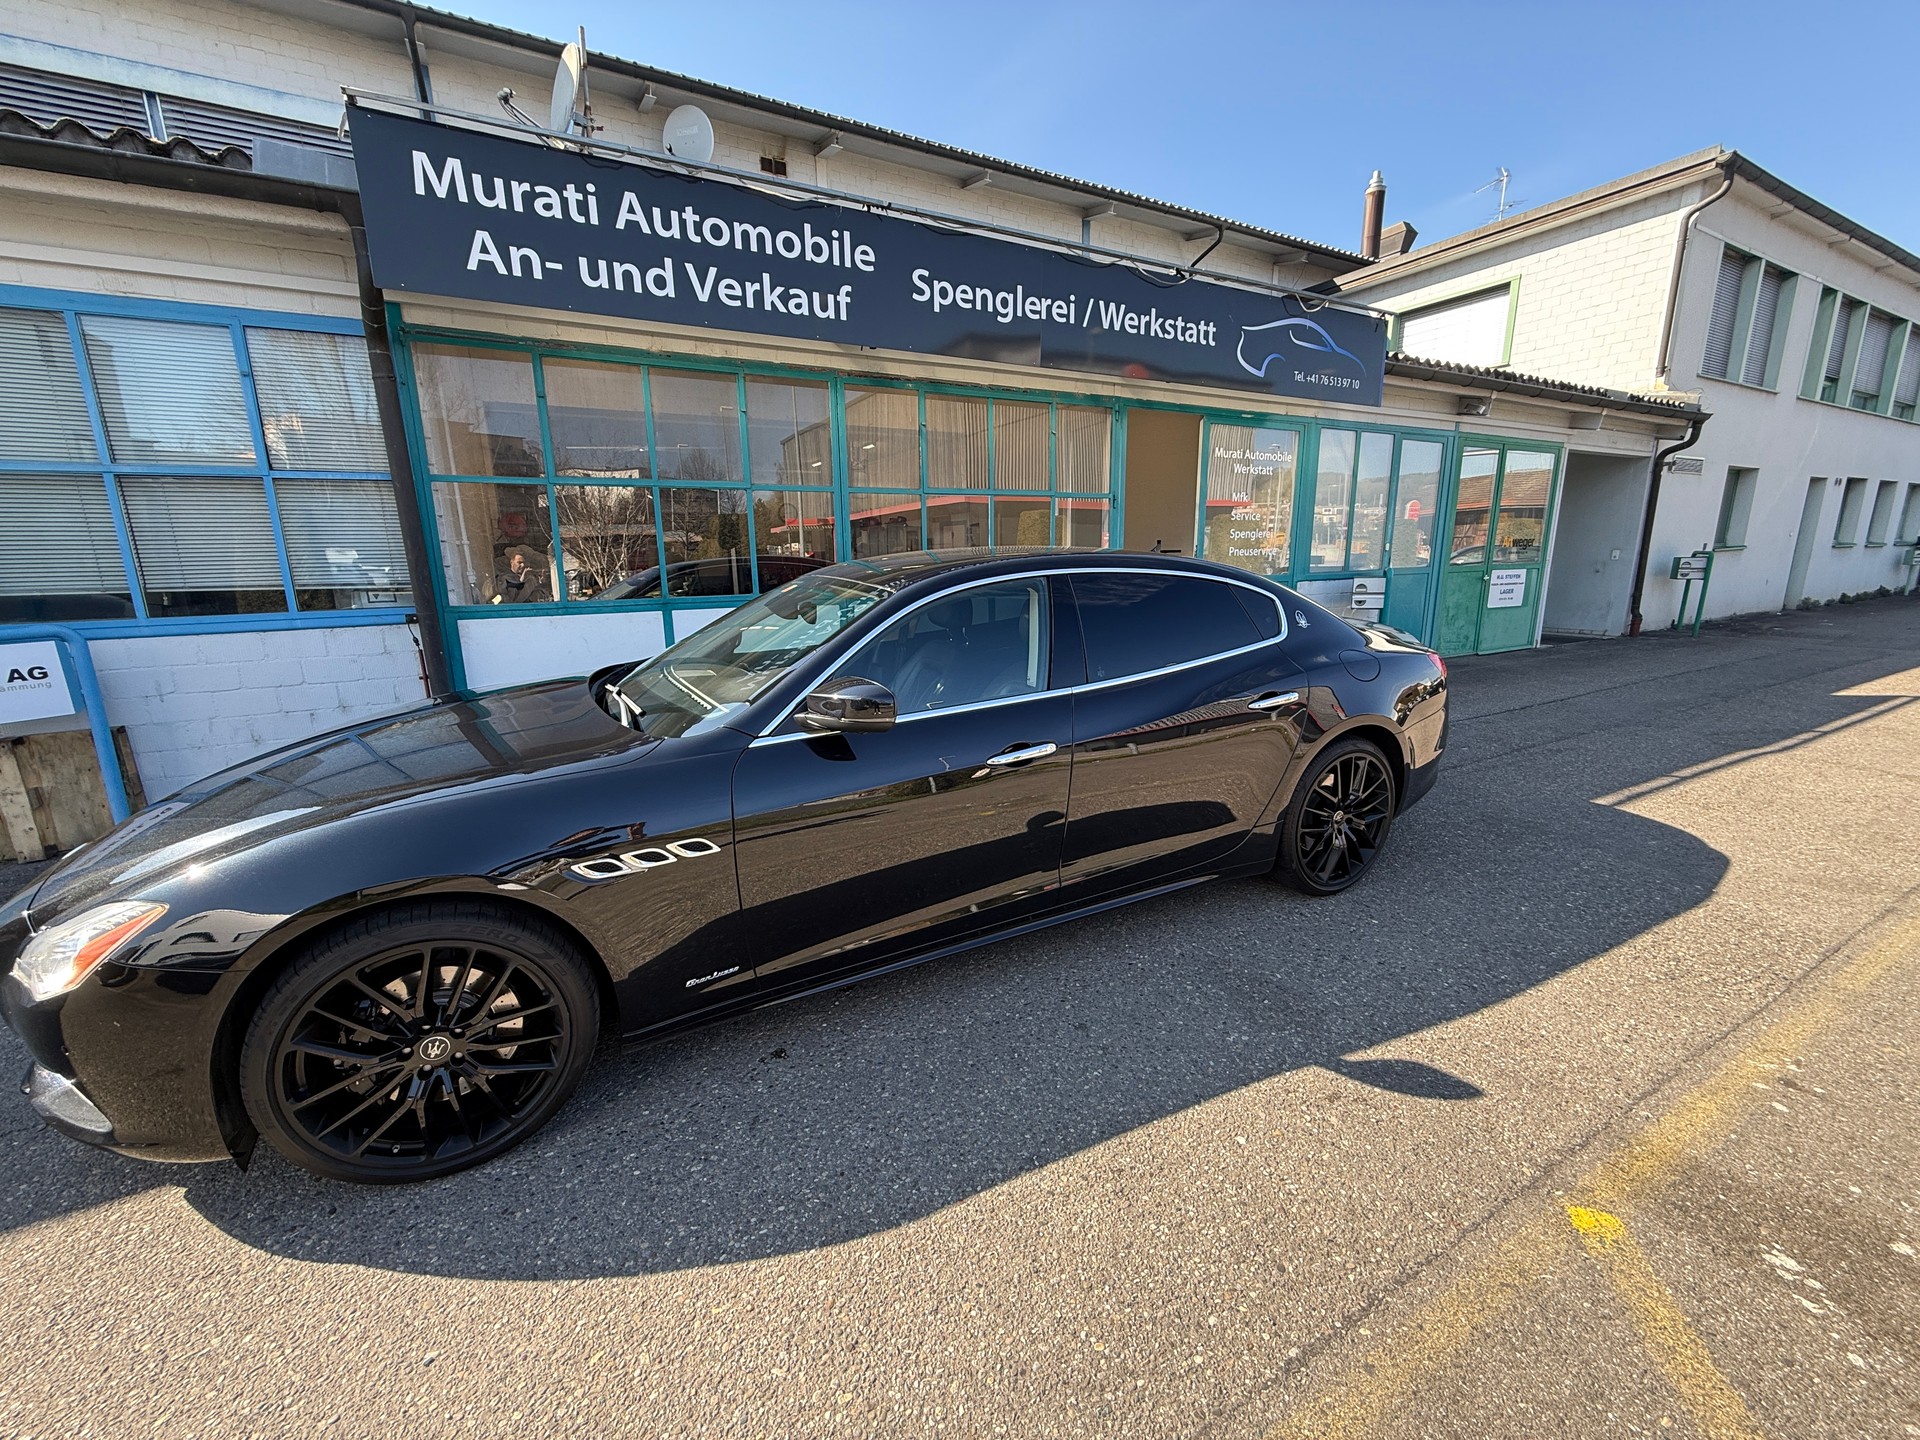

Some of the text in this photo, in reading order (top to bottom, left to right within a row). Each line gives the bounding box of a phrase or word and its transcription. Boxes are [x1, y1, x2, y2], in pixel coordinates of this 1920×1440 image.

[412, 150, 876, 272] Murati Automobile
[466, 229, 852, 321] An- und Verkauf
[911, 268, 1217, 347] Spenglerei / Werkstatt
[1294, 371, 1360, 389] Tel. +41 76 513 97 10
[1214, 447, 1292, 462] Murati Automobile
[1233, 463, 1273, 476] Werkstatt
[1231, 492, 1248, 502] Mfk
[1230, 508, 1261, 521] Service
[1229, 528, 1274, 541] Spenglerei
[1228, 546, 1277, 558] Pneuservice
[7, 665, 49, 683] AG
